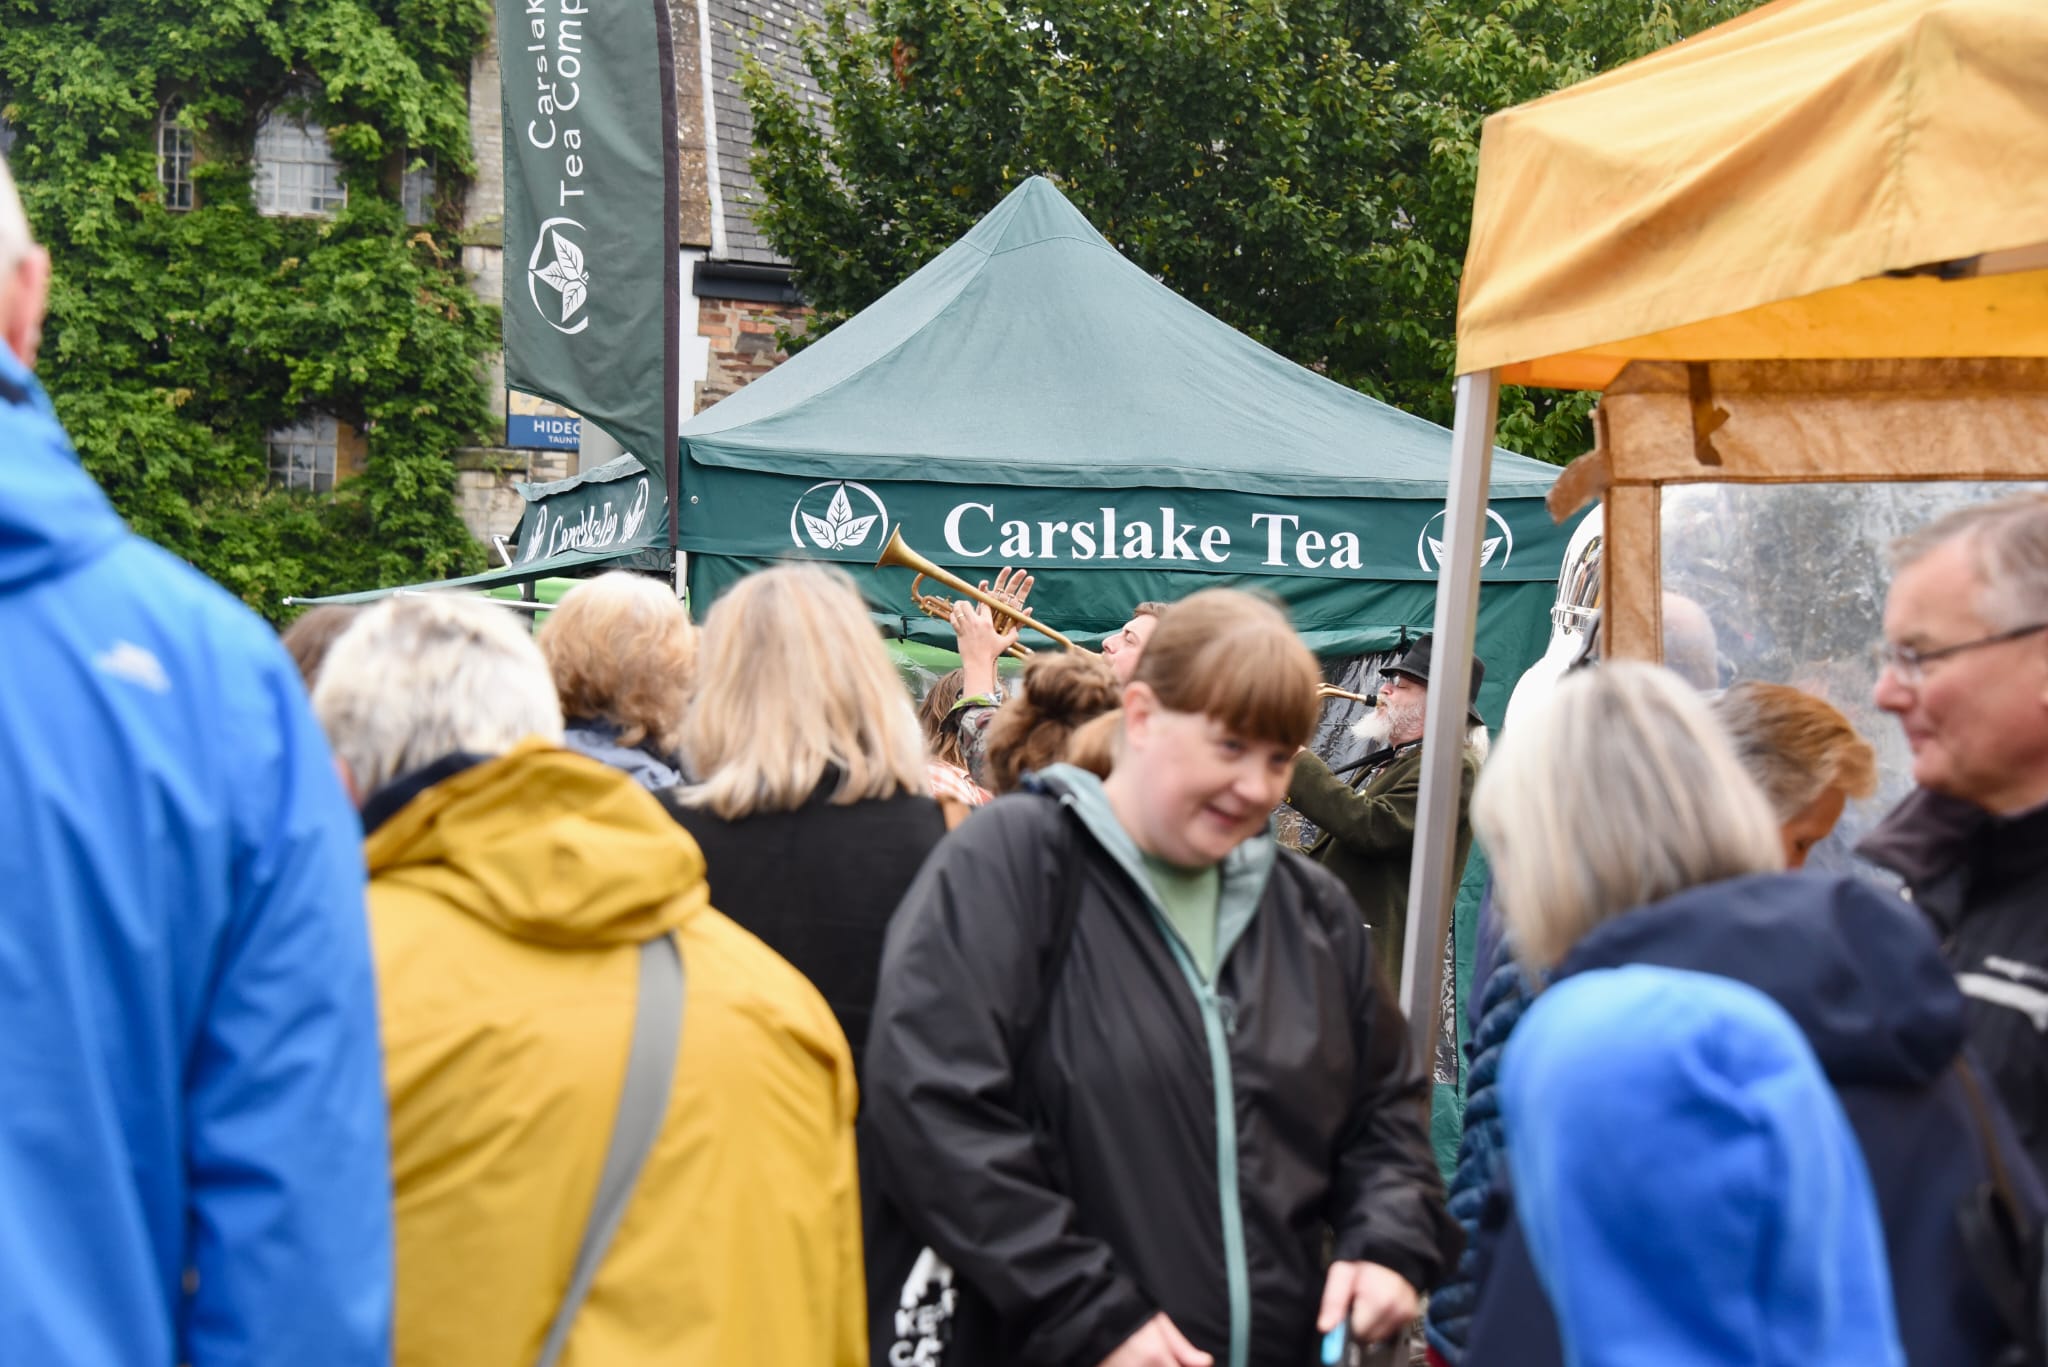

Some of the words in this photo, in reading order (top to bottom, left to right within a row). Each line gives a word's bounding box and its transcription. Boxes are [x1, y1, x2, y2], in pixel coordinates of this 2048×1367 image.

[552, 0, 589, 111] Comp
[560, 129, 585, 207] Tea
[548, 435, 580, 445] TAUNT
[943, 502, 1231, 563] Carslake
[1251, 513, 1363, 570] Tea
